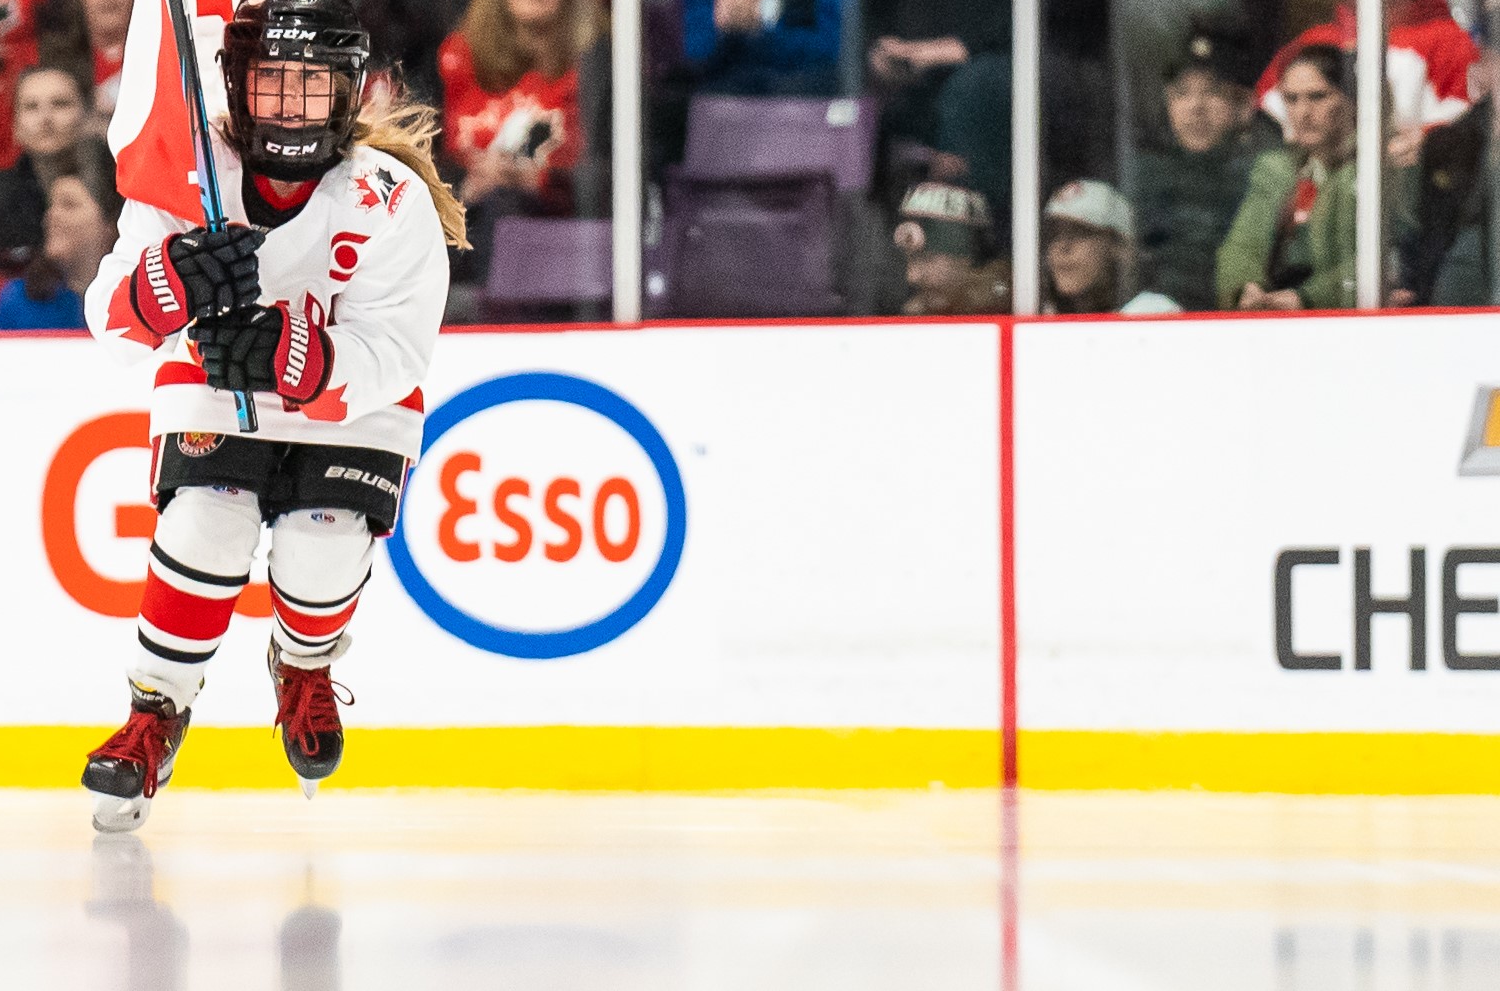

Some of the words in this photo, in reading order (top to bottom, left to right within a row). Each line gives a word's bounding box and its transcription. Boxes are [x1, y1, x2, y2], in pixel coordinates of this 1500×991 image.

[265, 141, 318, 157] CCM
[325, 465, 400, 500] BAUER
[1274, 546, 1500, 672] CHE
